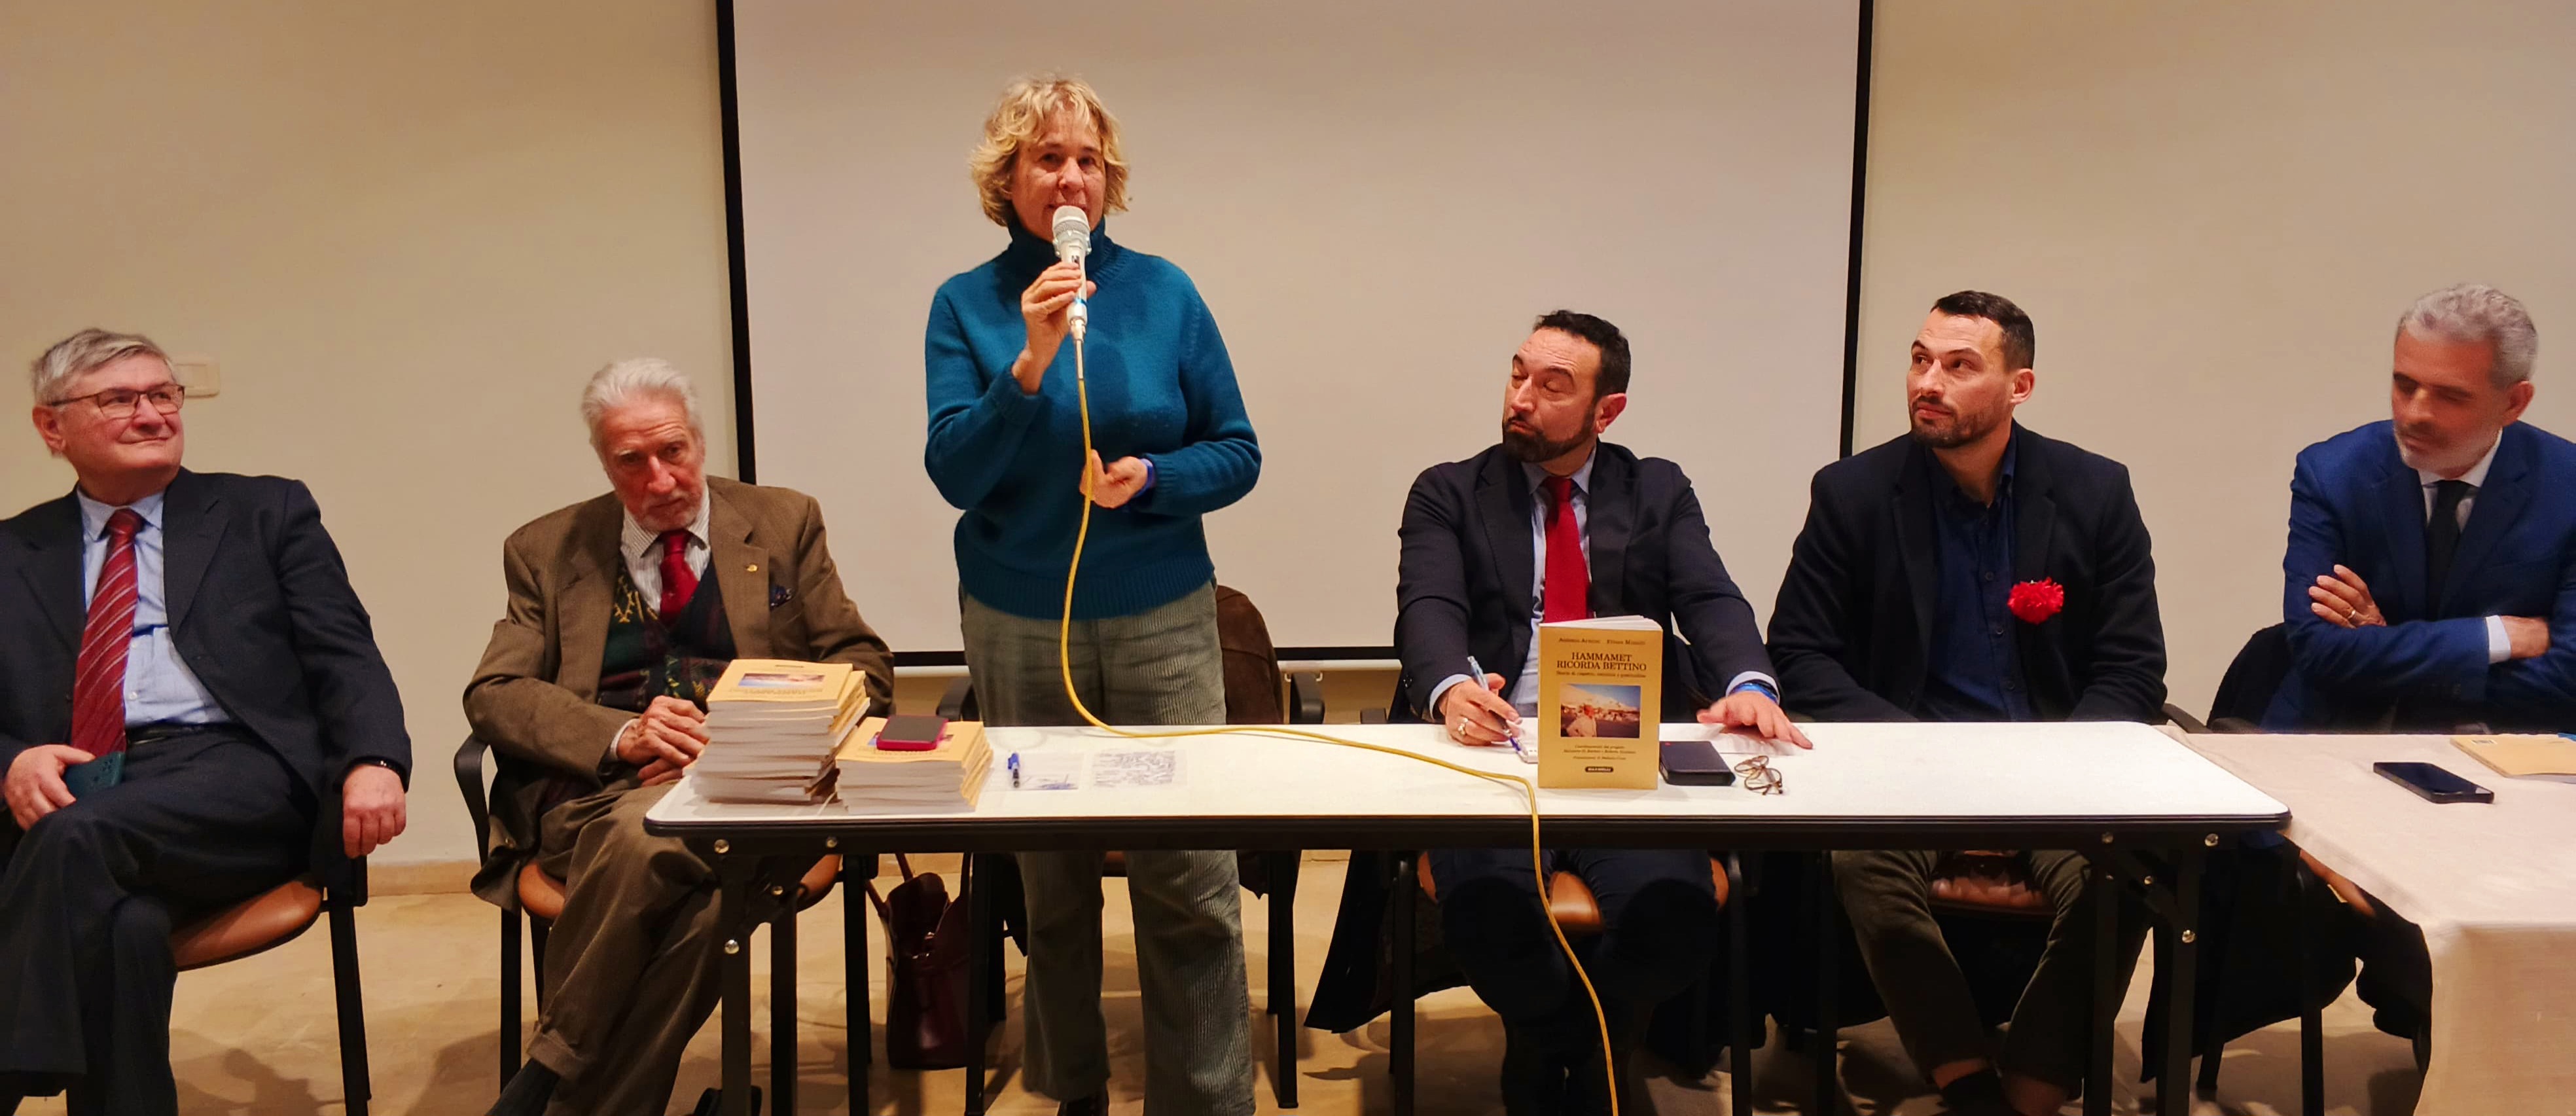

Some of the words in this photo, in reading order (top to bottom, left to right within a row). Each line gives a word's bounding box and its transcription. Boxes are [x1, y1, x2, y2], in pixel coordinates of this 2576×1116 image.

[1571, 652, 1633, 662] HAMMAMET
[1557, 660, 1601, 670] RICORDA
[1603, 662, 1647, 671] BETTINO
